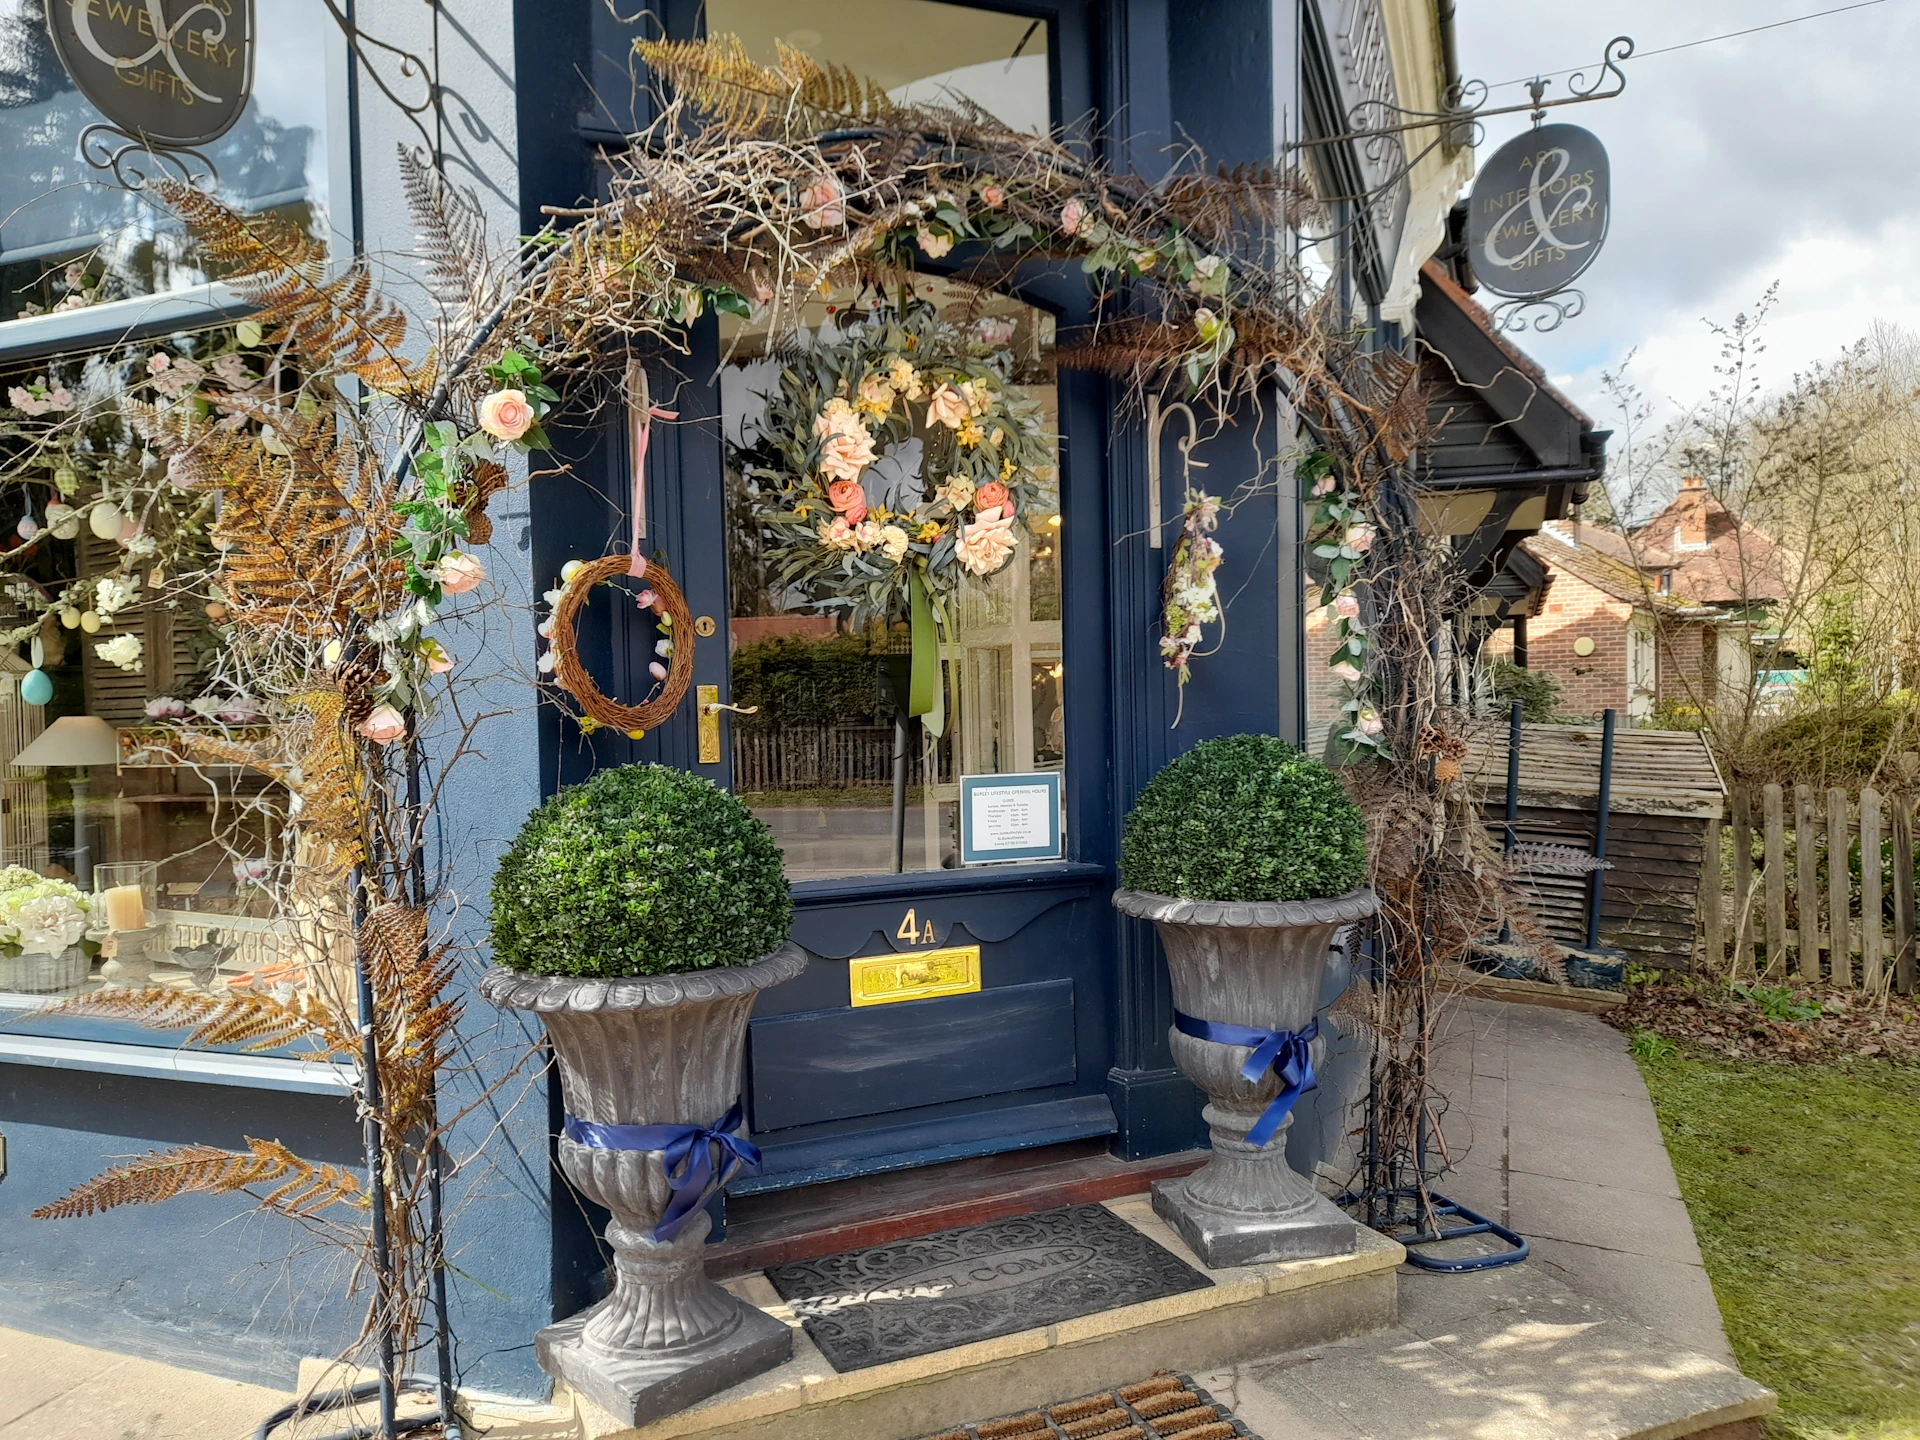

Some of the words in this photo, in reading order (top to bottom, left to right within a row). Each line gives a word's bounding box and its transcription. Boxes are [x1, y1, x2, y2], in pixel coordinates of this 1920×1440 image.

[66, 0, 237, 68] EWELLERY
[114, 57, 194, 105] GIFTS
[1518, 147, 1559, 172] ART
[1508, 246, 1567, 271] GIFTS
